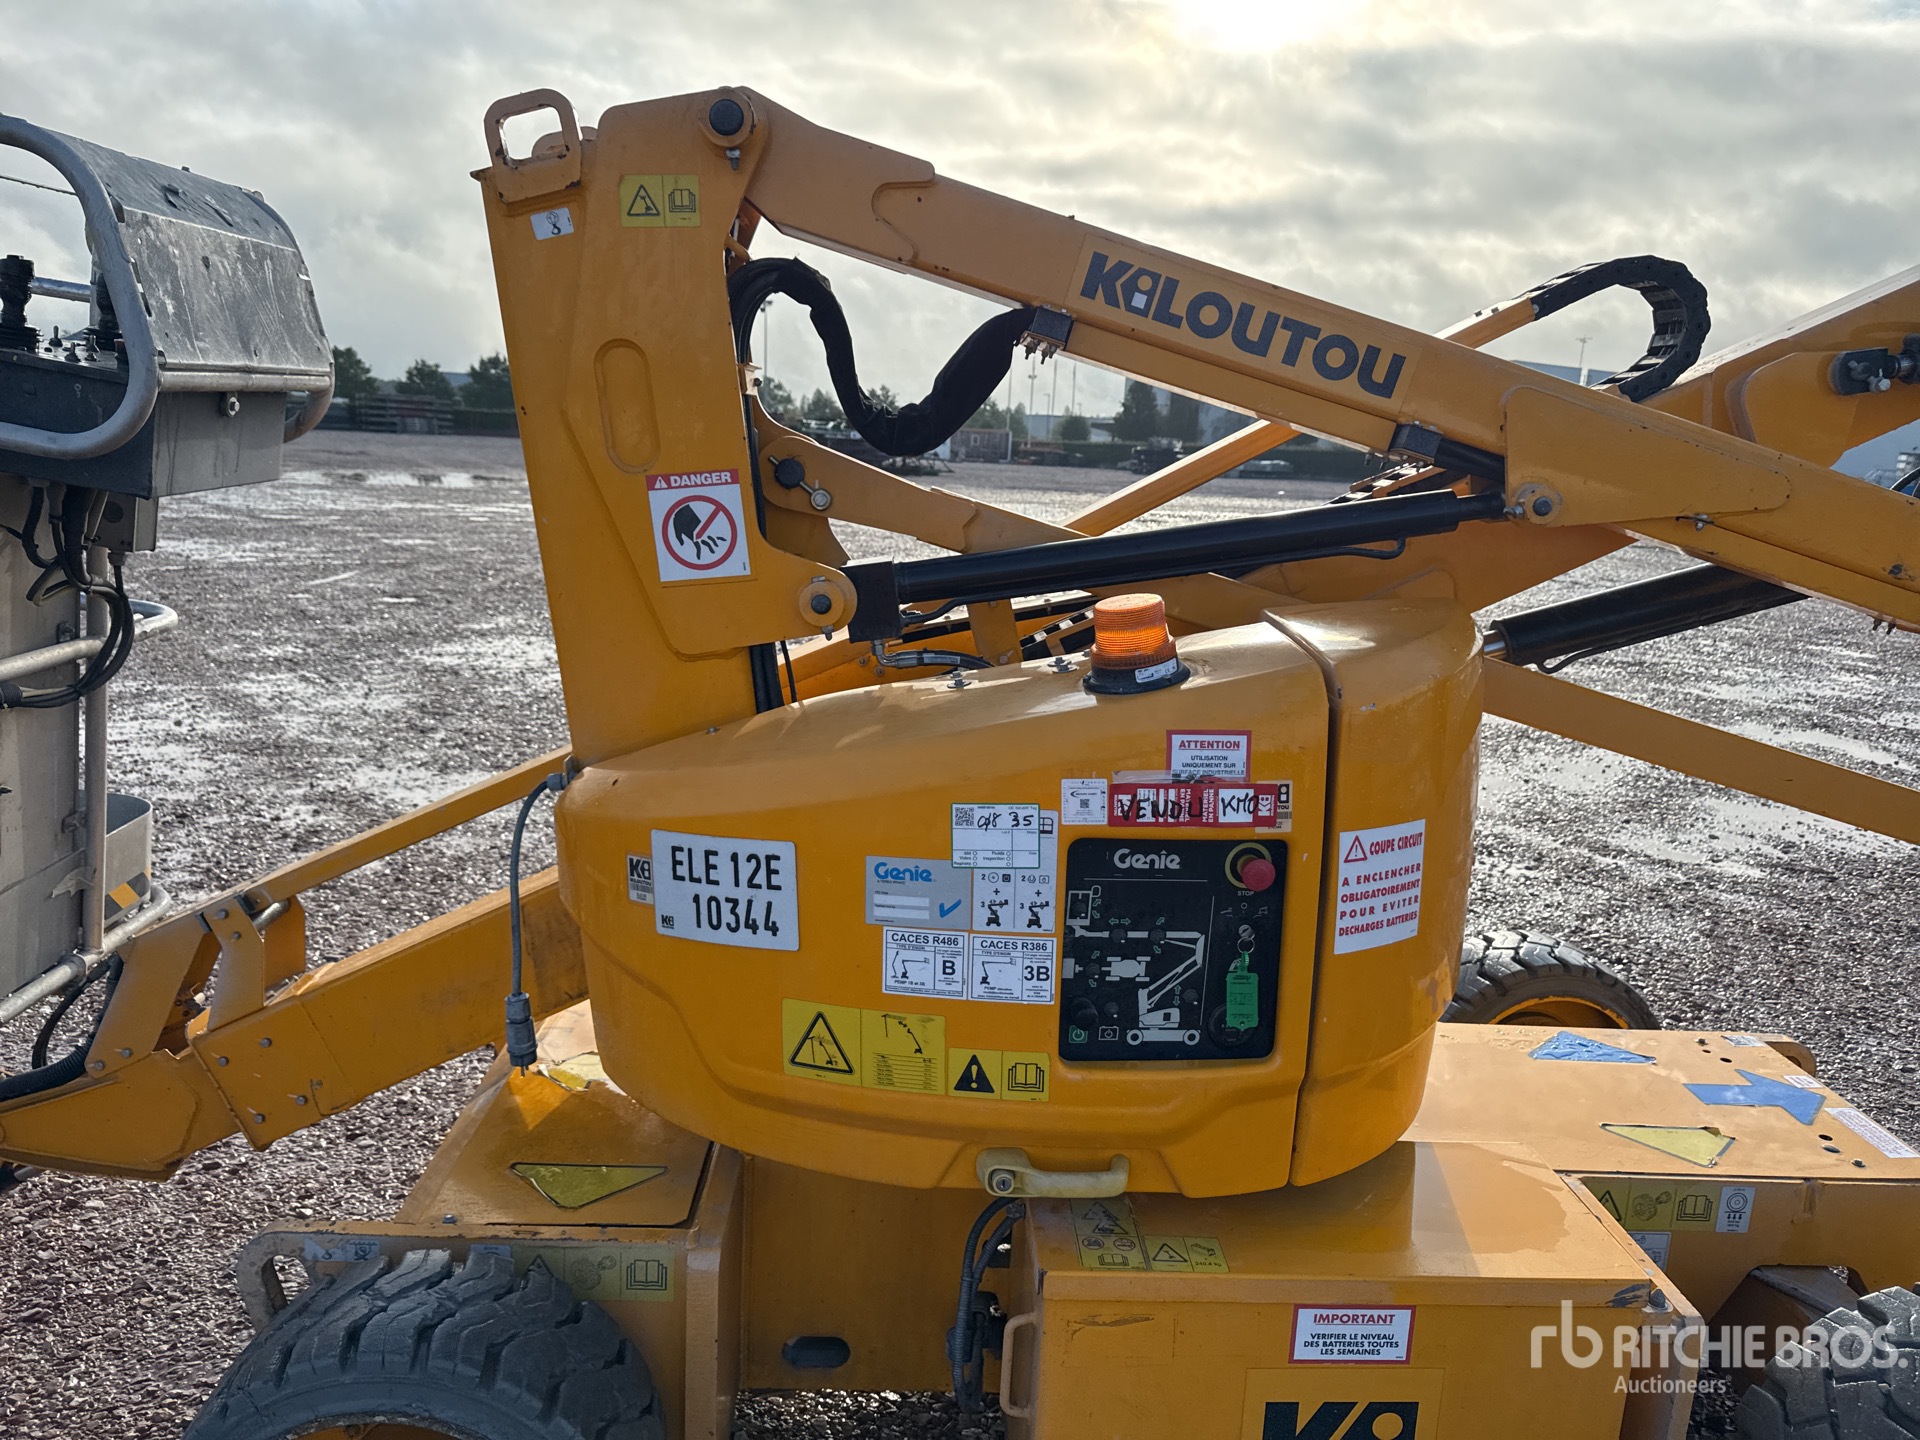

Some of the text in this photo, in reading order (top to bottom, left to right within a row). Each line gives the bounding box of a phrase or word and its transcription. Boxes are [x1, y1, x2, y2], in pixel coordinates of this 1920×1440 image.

[1080, 251, 1407, 399] KILOUTOU
[669, 472, 732, 487] DANGER
[1178, 740, 1241, 750] ATTENTION
[1369, 832, 1423, 856] COUPE CIRCUIT
[671, 845, 782, 891] ELE 12E
[1113, 848, 1181, 870] Genie
[874, 862, 933, 882] Genie
[1341, 862, 1421, 887] A ENCLENCHER
[1340, 878, 1421, 903] OBLIGATOIREMENT
[692, 893, 780, 937] 10344
[1340, 894, 1419, 920] POUR EVITER
[1338, 910, 1418, 937] DECHARGES BATTERIES
[891, 933, 959, 946] CACES R486
[980, 940, 1048, 951] CACES R386
[942, 960, 956, 976] B
[1024, 965, 1050, 982] 3B
[1313, 1313, 1396, 1324] IMPORTANT
[1303, 1340, 1320, 1348] DES
[1322, 1340, 1365, 1348] BATTERIES
[1360, 1333, 1395, 1341] NIVEAU
[1337, 1348, 1381, 1356] SEMAINES
